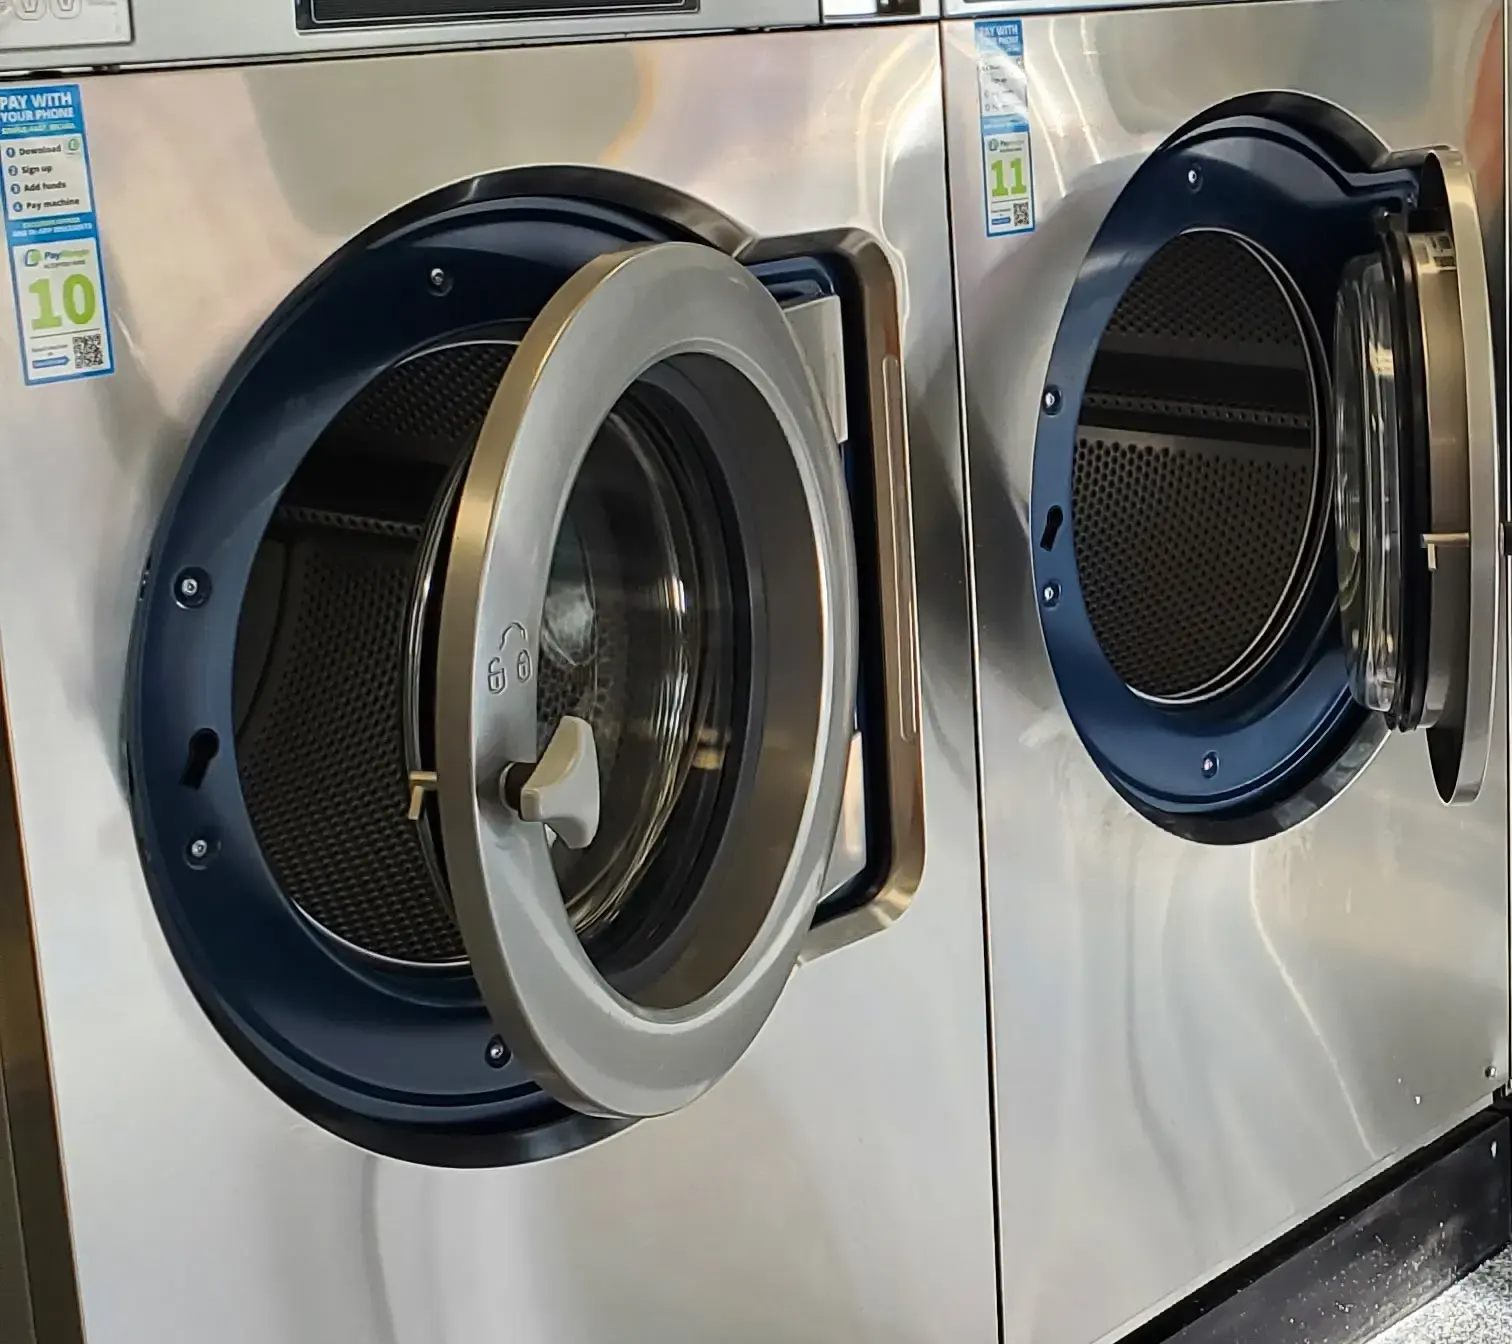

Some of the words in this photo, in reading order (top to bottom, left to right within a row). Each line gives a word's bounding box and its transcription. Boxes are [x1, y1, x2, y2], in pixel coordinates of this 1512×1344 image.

[978, 26, 996, 37] AY
[996, 24, 1018, 36] WITH
[0, 94, 28, 110] PAY
[30, 91, 73, 107] WITH
[0, 110, 33, 123] YOUR
[35, 107, 74, 120] PHONE
[19, 144, 61, 156] Download
[21, 166, 40, 175] Sign
[41, 165, 53, 173] up
[991, 157, 1027, 197] 11
[24, 183, 41, 192] Add
[42, 181, 67, 190] funds
[26, 202, 41, 210] Pay
[43, 198, 80, 207] machine
[28, 273, 96, 330] 10
